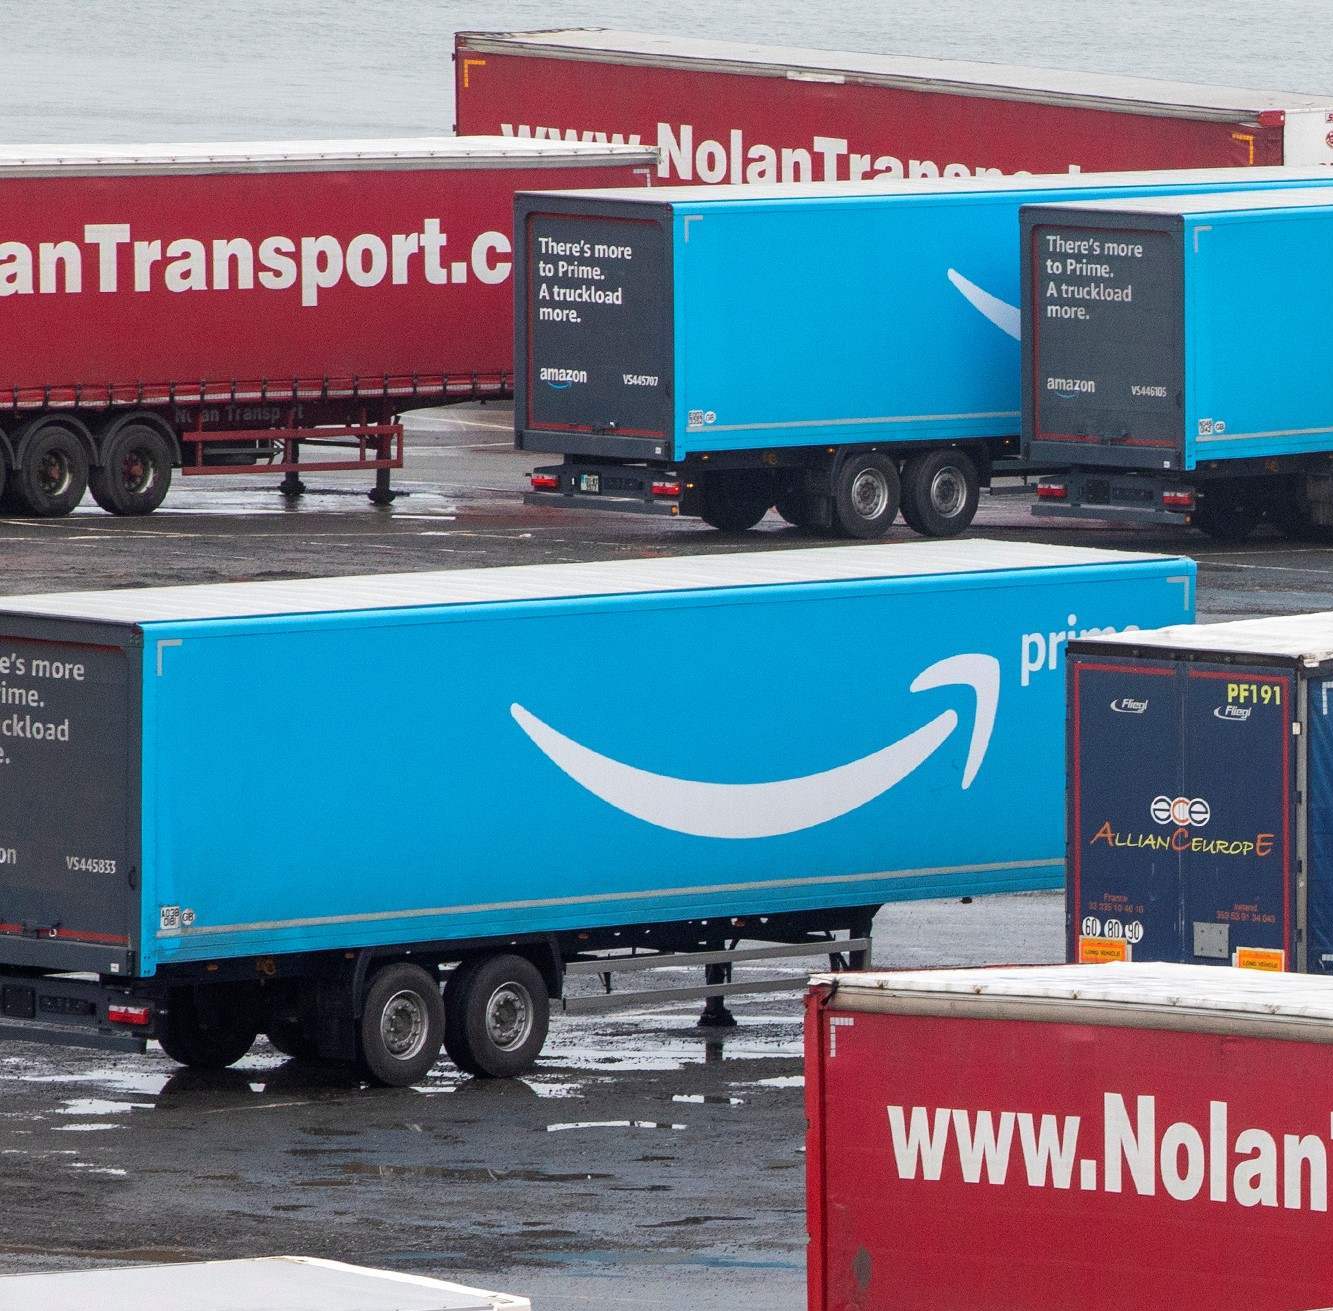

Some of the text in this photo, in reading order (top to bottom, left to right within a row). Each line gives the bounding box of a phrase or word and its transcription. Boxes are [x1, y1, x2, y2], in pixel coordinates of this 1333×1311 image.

[539, 237, 632, 260] There's more
[1046, 235, 1143, 257] There's more
[539, 261, 605, 280] to Prime.
[1046, 259, 1114, 278] to Prime.
[539, 284, 622, 305] A truckload
[1047, 282, 1132, 301] A truckload
[539, 307, 581, 323] more.
[1047, 304, 1090, 320] more.
[540, 368, 587, 384] amazon
[1047, 377, 1096, 393] amazon
[31, 659, 85, 681] more
[1227, 683, 1281, 705] PF191
[66, 856, 117, 874] VS445833
